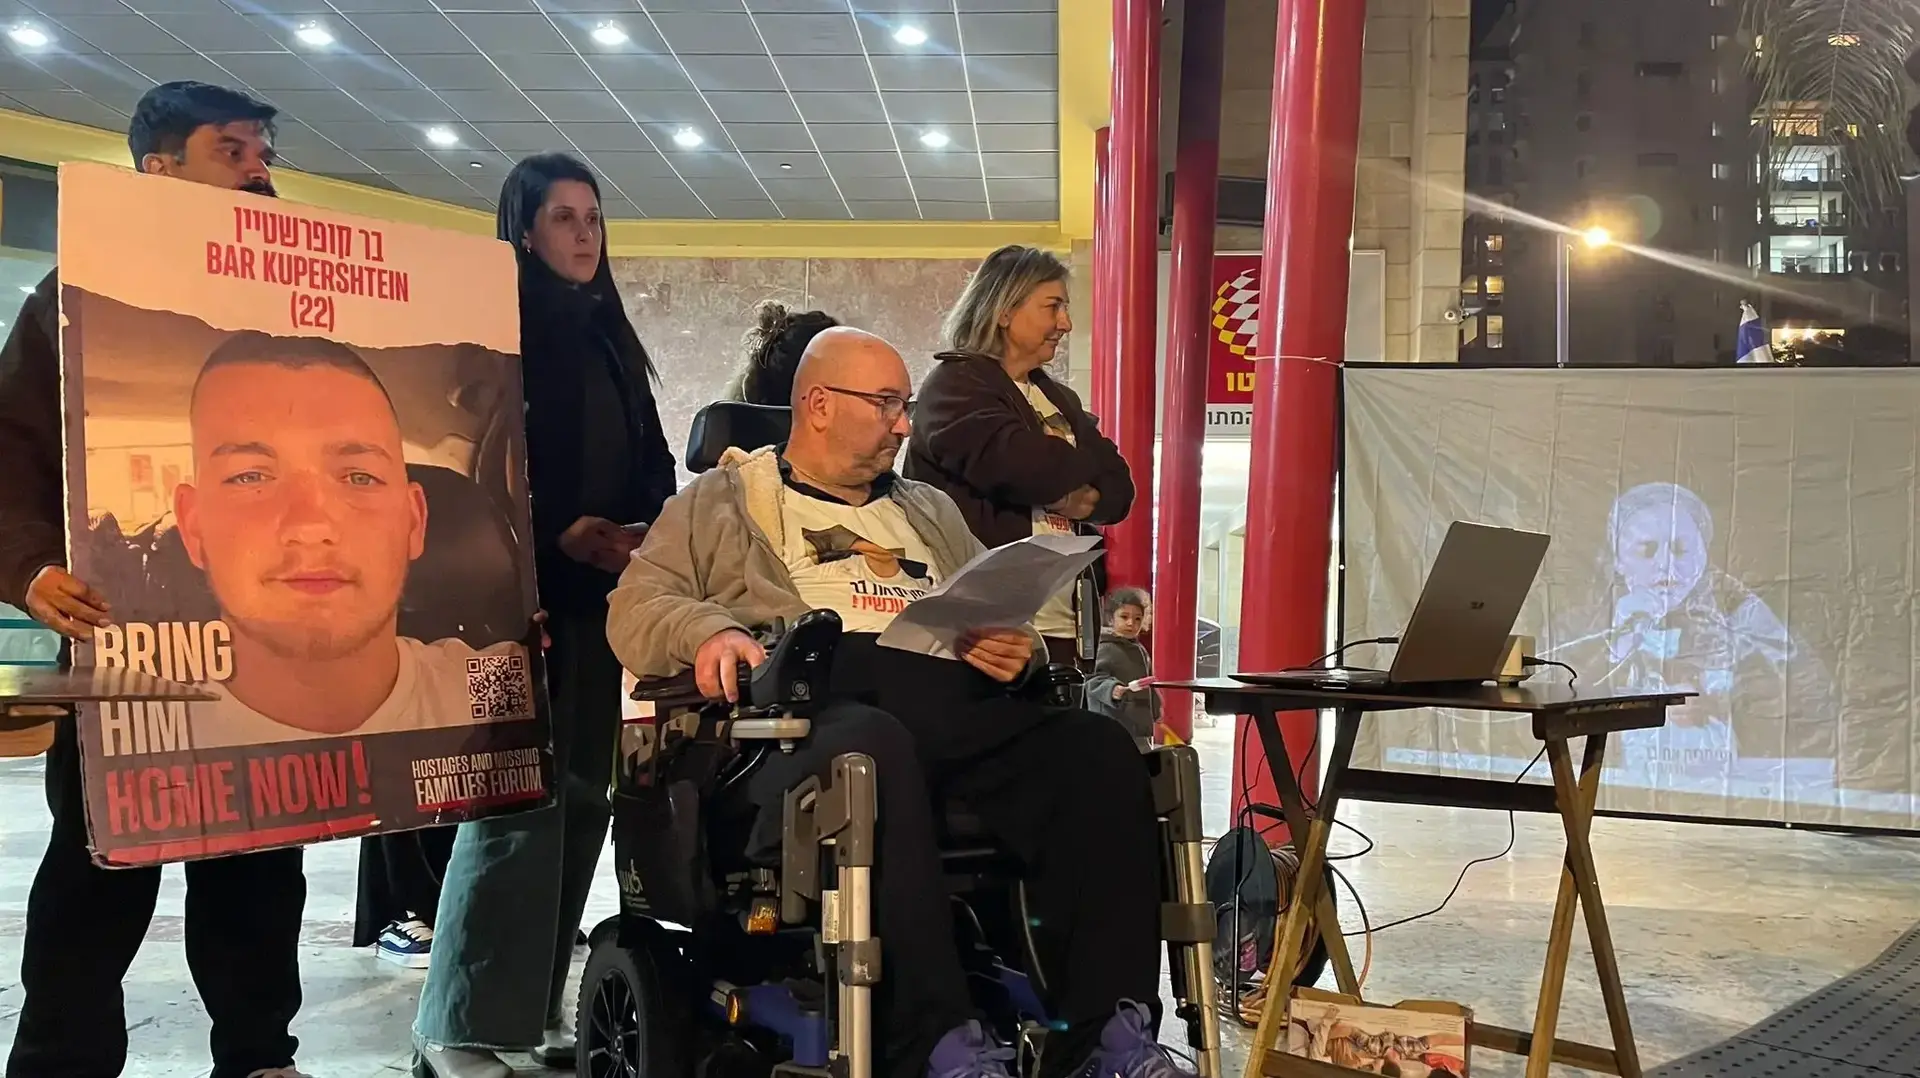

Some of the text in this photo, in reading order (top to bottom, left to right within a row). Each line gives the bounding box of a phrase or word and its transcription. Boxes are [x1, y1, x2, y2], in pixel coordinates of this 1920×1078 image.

[234, 206, 384, 262] בר קופרשטיין
[206, 241, 409, 302] BAR KUPERSHTEIN
[290, 291, 335, 332] (22)
[1226, 372, 1256, 392] טו
[1207, 411, 1252, 425] המתו
[94, 620, 233, 682] BRING
[99, 701, 190, 757] HIM
[411, 747, 540, 778] HOSTAGES AND MISSING
[414, 766, 542, 806] FAMILIES FORUM
[105, 740, 372, 835] HOME NOW!
